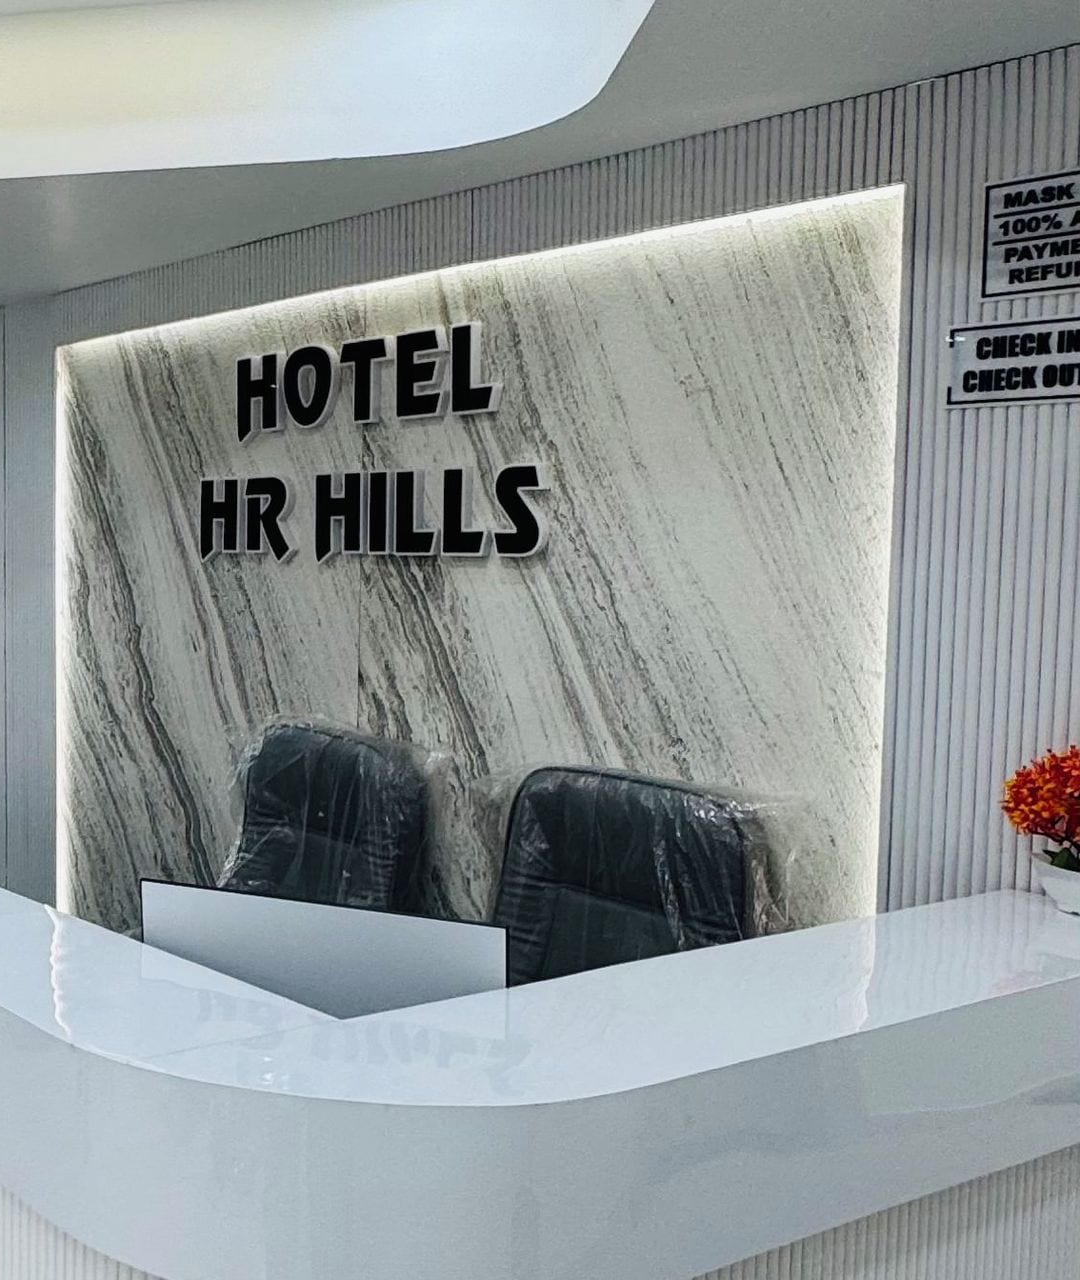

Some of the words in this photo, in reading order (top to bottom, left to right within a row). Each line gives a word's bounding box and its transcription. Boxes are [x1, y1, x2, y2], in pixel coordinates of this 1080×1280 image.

[1003, 183, 1075, 209] MASK
[998, 213, 1063, 237] 100%
[976, 331, 1053, 360] CHECK
[236, 322, 500, 443] HOTEL
[962, 366, 1038, 394] CHECK
[199, 475, 294, 564] HR
[314, 464, 547, 564] HILLS
